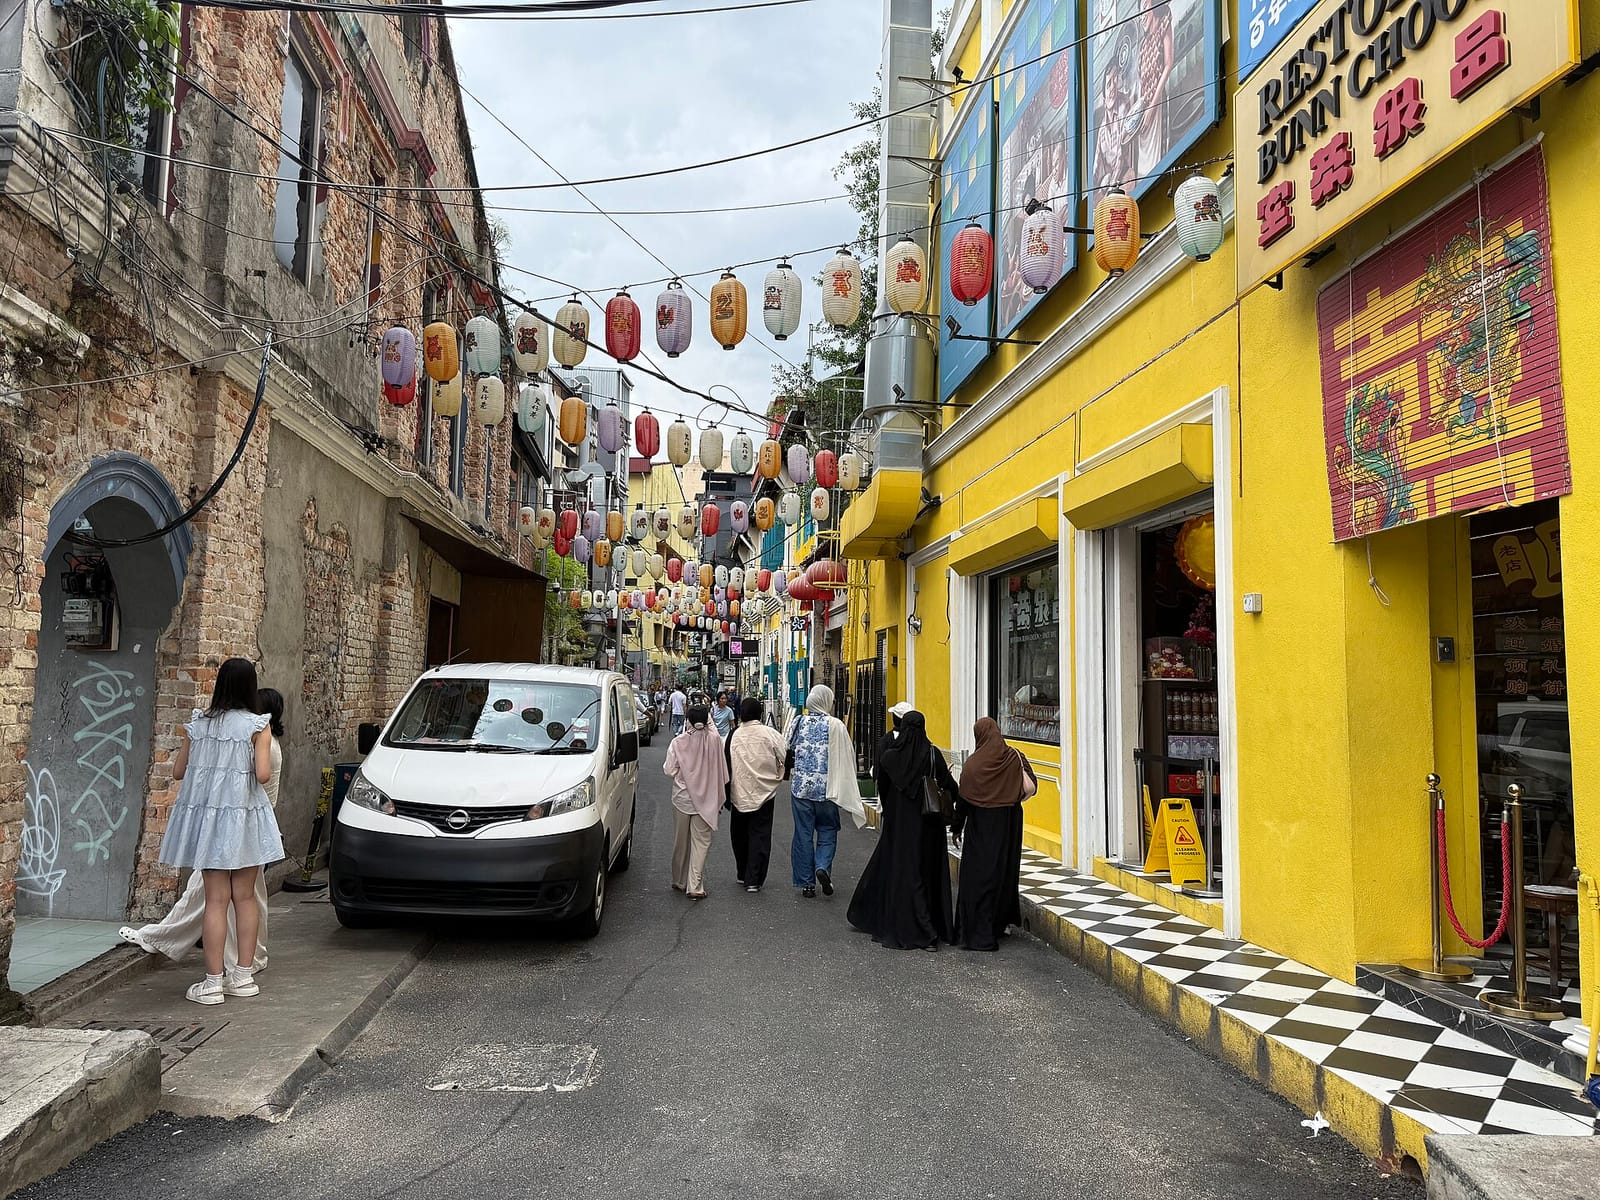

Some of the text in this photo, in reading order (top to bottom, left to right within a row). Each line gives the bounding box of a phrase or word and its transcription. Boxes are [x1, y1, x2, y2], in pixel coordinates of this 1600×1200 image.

[1257, 75, 1343, 185] BUNN
[1499, 544, 1522, 574] 老店
[1541, 616, 1565, 696] 结婚礼饼
